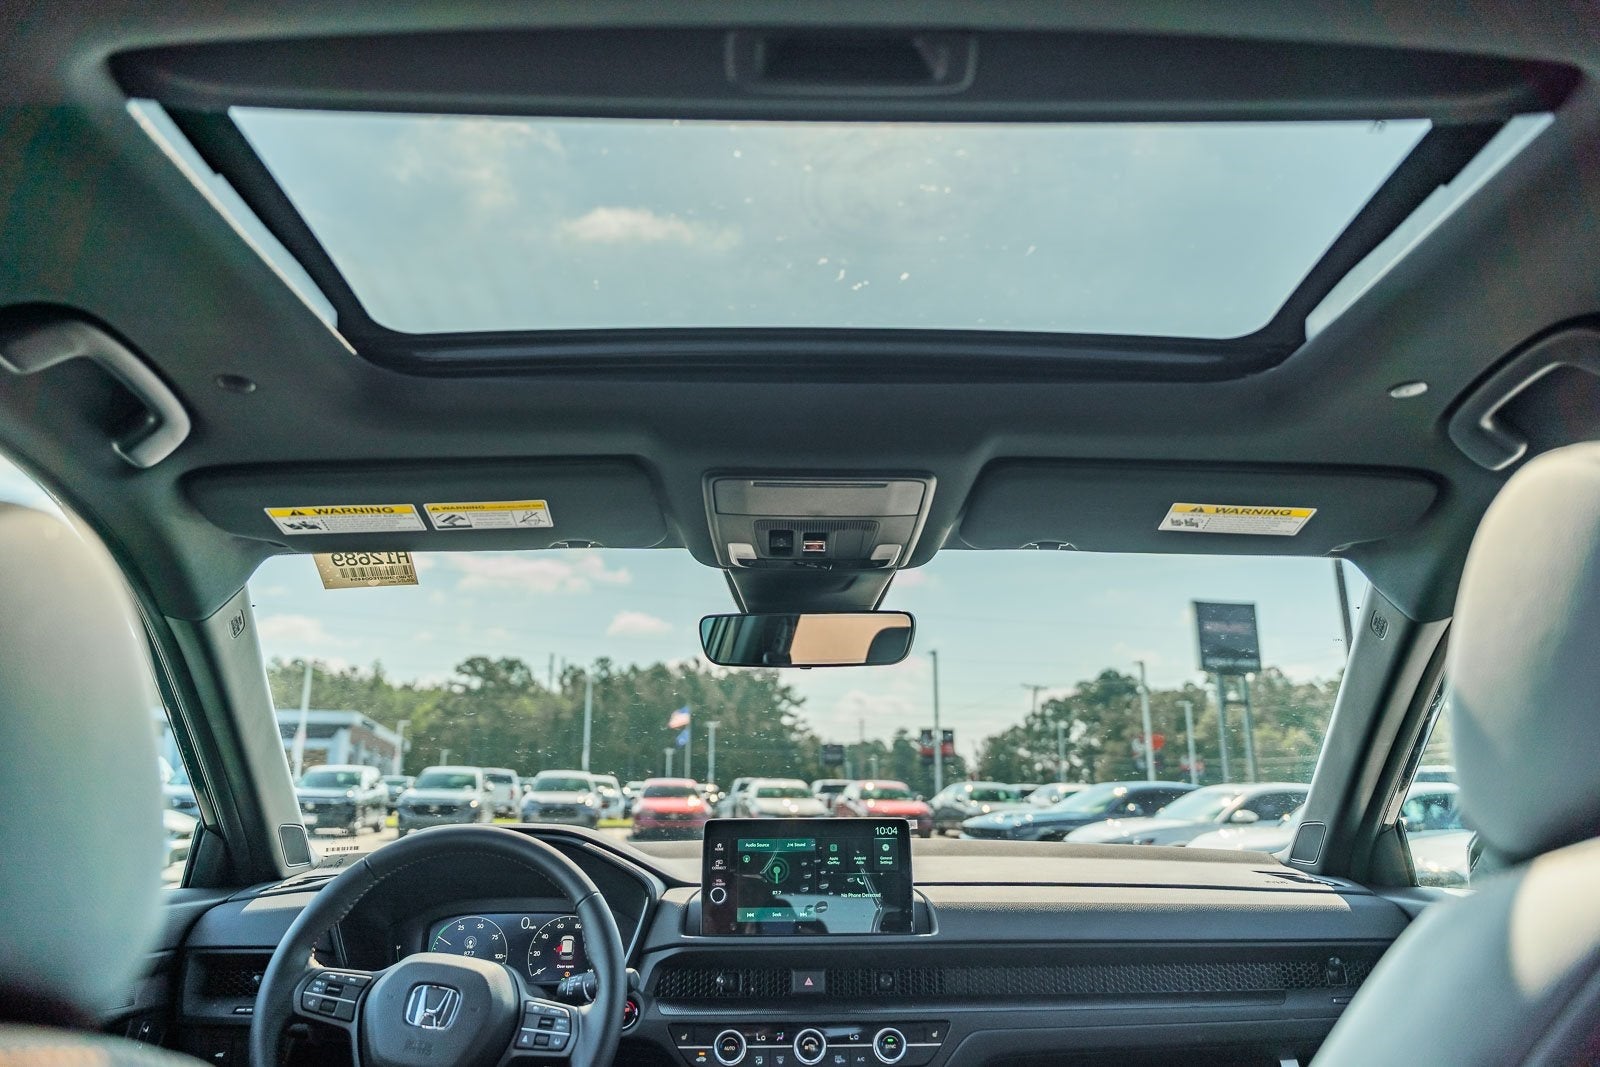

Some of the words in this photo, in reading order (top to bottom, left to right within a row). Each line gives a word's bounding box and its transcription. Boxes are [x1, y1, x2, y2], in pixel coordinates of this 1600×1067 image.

[313, 506, 395, 514] WARNING
[1215, 507, 1292, 516] WARNING
[875, 826, 898, 835] 10:04
[520, 916, 530, 930] 0
[756, 1032, 766, 1041] Lo
